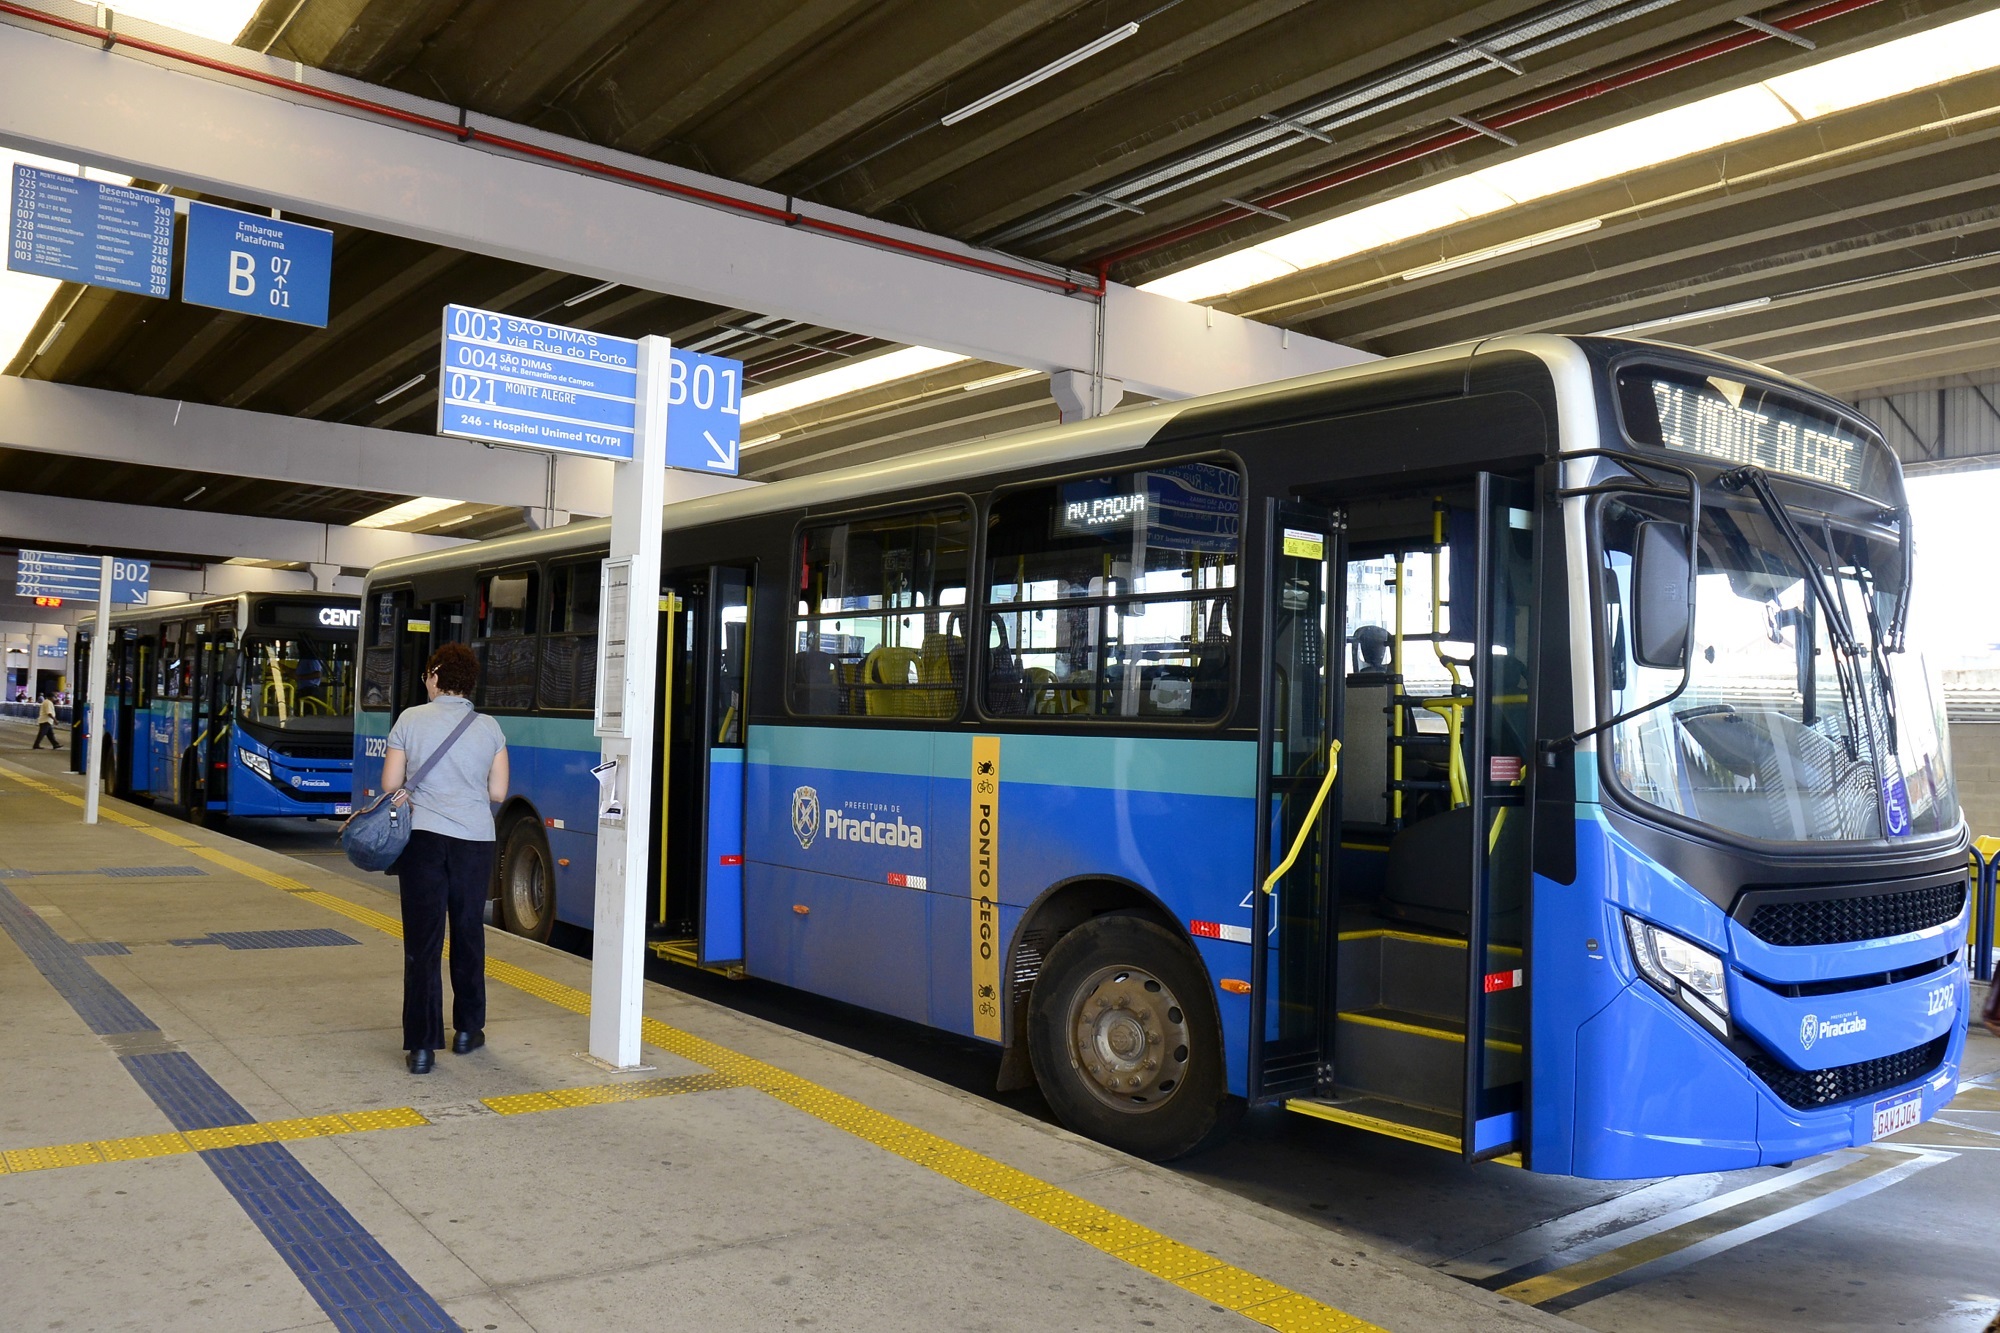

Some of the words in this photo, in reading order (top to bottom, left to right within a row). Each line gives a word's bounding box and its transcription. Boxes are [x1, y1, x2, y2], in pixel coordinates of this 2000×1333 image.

[20, 168, 36, 179] 021
[19, 178, 36, 189] 225
[18, 188, 35, 200] 222
[99, 184, 160, 205] Desembarque
[18, 199, 35, 210] 219
[17, 209, 34, 220] 007
[154, 206, 170, 216] 240
[16, 219, 34, 230] 228
[154, 216, 170, 226] 223
[16, 230, 33, 240] 210
[154, 226, 170, 236] 223
[238, 221, 283, 238] Embarque
[15, 240, 32, 250] 003
[153, 236, 169, 246] 220
[235, 232, 285, 249] Plataforma
[14, 250, 31, 261] 003
[152, 245, 168, 256] 218
[151, 255, 167, 266] 246
[271, 256, 291, 275] 07
[150, 265, 167, 275] 002
[229, 250, 255, 296] B
[150, 275, 166, 285] 210
[150, 285, 166, 295] 207
[270, 289, 290, 307] 01
[455, 310, 501, 342] 003
[508, 318, 542, 336] SÃO
[547, 327, 598, 346] DIMAS
[506, 336, 528, 348] via
[533, 340, 562, 354] Rua
[567, 346, 584, 358] do
[590, 349, 626, 366] Porto
[459, 347, 497, 370] 004
[500, 354, 519, 365] SÃO
[522, 358, 552, 371] DIMAS
[520, 368, 557, 380] Bernardino
[568, 377, 594, 386] Campos
[452, 373, 496, 406] 021
[505, 382, 538, 398] MONTE
[541, 389, 576, 405] ALEGRE
[668, 358, 738, 415] B01
[461, 415, 482, 426] 246
[494, 420, 538, 434] Hospital
[542, 427, 582, 442] Unimed
[585, 434, 621, 447] TCI/TPI
[1695, 395, 1769, 468] MONTE
[22, 552, 42, 562] 007
[21, 563, 42, 573] 219
[113, 562, 149, 582] B02
[21, 574, 40, 583] 222
[20, 585, 40, 595] 225
[319, 608, 360, 626] CENT
[365, 738, 387, 758] 12292
[844, 801, 888, 812] PREFEITURA
[825, 809, 922, 849] Piracicaba
[979, 804, 990, 887] PONTO
[980, 896, 991, 960] CEGO
[1928, 983, 1954, 1016] 12292
[1819, 1016, 1866, 1039] Piracicaba
